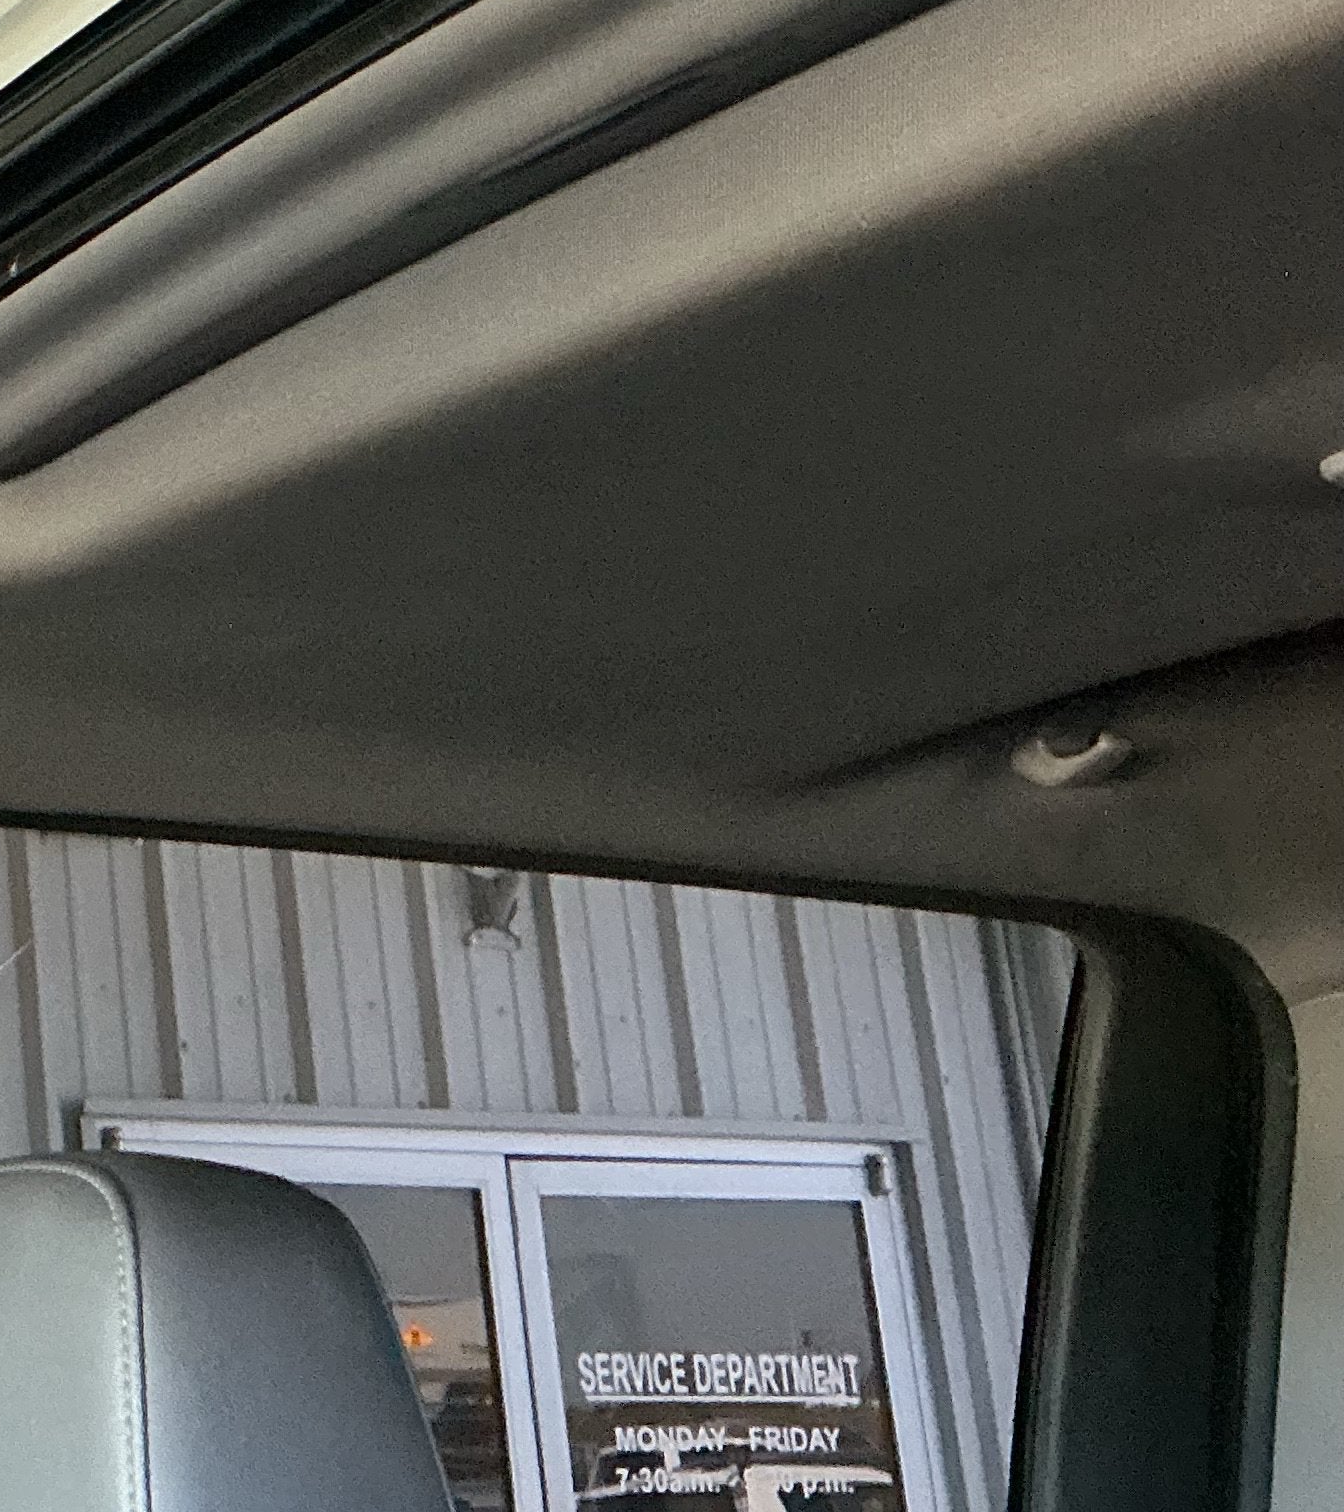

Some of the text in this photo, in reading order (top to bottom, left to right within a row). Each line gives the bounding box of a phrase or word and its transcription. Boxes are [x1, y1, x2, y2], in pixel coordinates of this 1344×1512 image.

[577, 1352, 860, 1395] SERVICE DEPARTMENT
[614, 1425, 840, 1452] MONDAY FRIDAY
